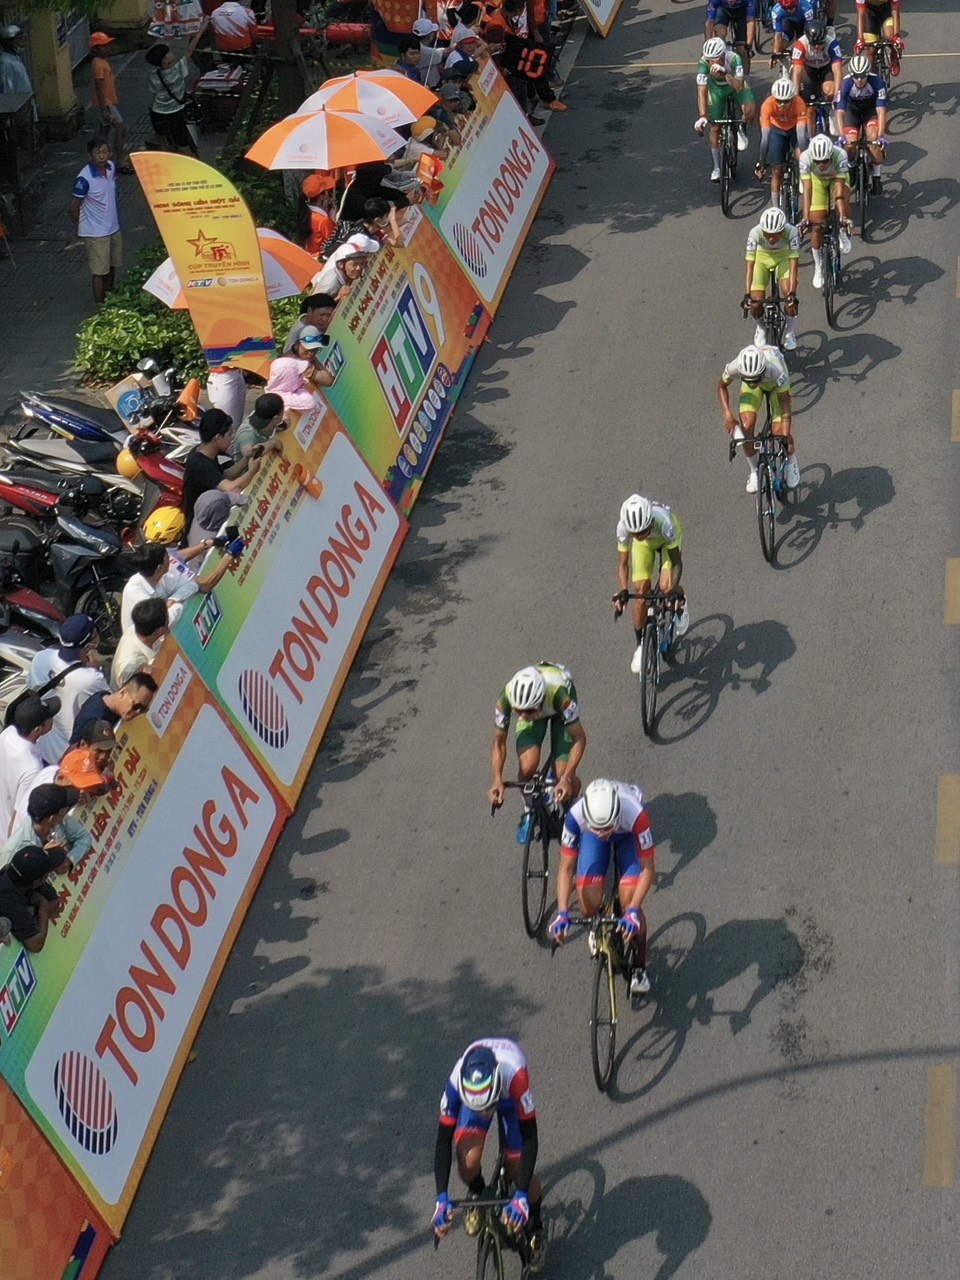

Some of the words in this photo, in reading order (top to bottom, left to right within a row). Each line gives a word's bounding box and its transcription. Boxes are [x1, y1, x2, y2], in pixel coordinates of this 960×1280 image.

[518, 47, 548, 79] 10
[471, 190, 509, 256] TON
[492, 139, 535, 216] DONG
[518, 126, 540, 163] A
[187, 278, 213, 288] HTV
[373, 290, 432, 426] HTV
[413, 262, 446, 347] 9
[302, 423, 313, 439] TON
[258, 495, 271, 522] LIỀN
[268, 472, 283, 498] MỘT
[194, 592, 221, 649] HTV
[269, 599, 329, 705] TON
[305, 504, 371, 629] DONG
[353, 480, 386, 532] A
[158, 699, 173, 719] TON
[168, 673, 185, 702] DONG
[180, 667, 188, 677] A
[90, 805, 110, 842] LIỀN
[106, 773, 129, 807] MỘT
[125, 744, 142, 777] DẢI
[127, 819, 140, 839] HTV
[95, 939, 177, 1087] TON
[150, 799, 239, 971] DONG
[220, 765, 260, 830] A
[0, 945, 34, 1030] HTV
